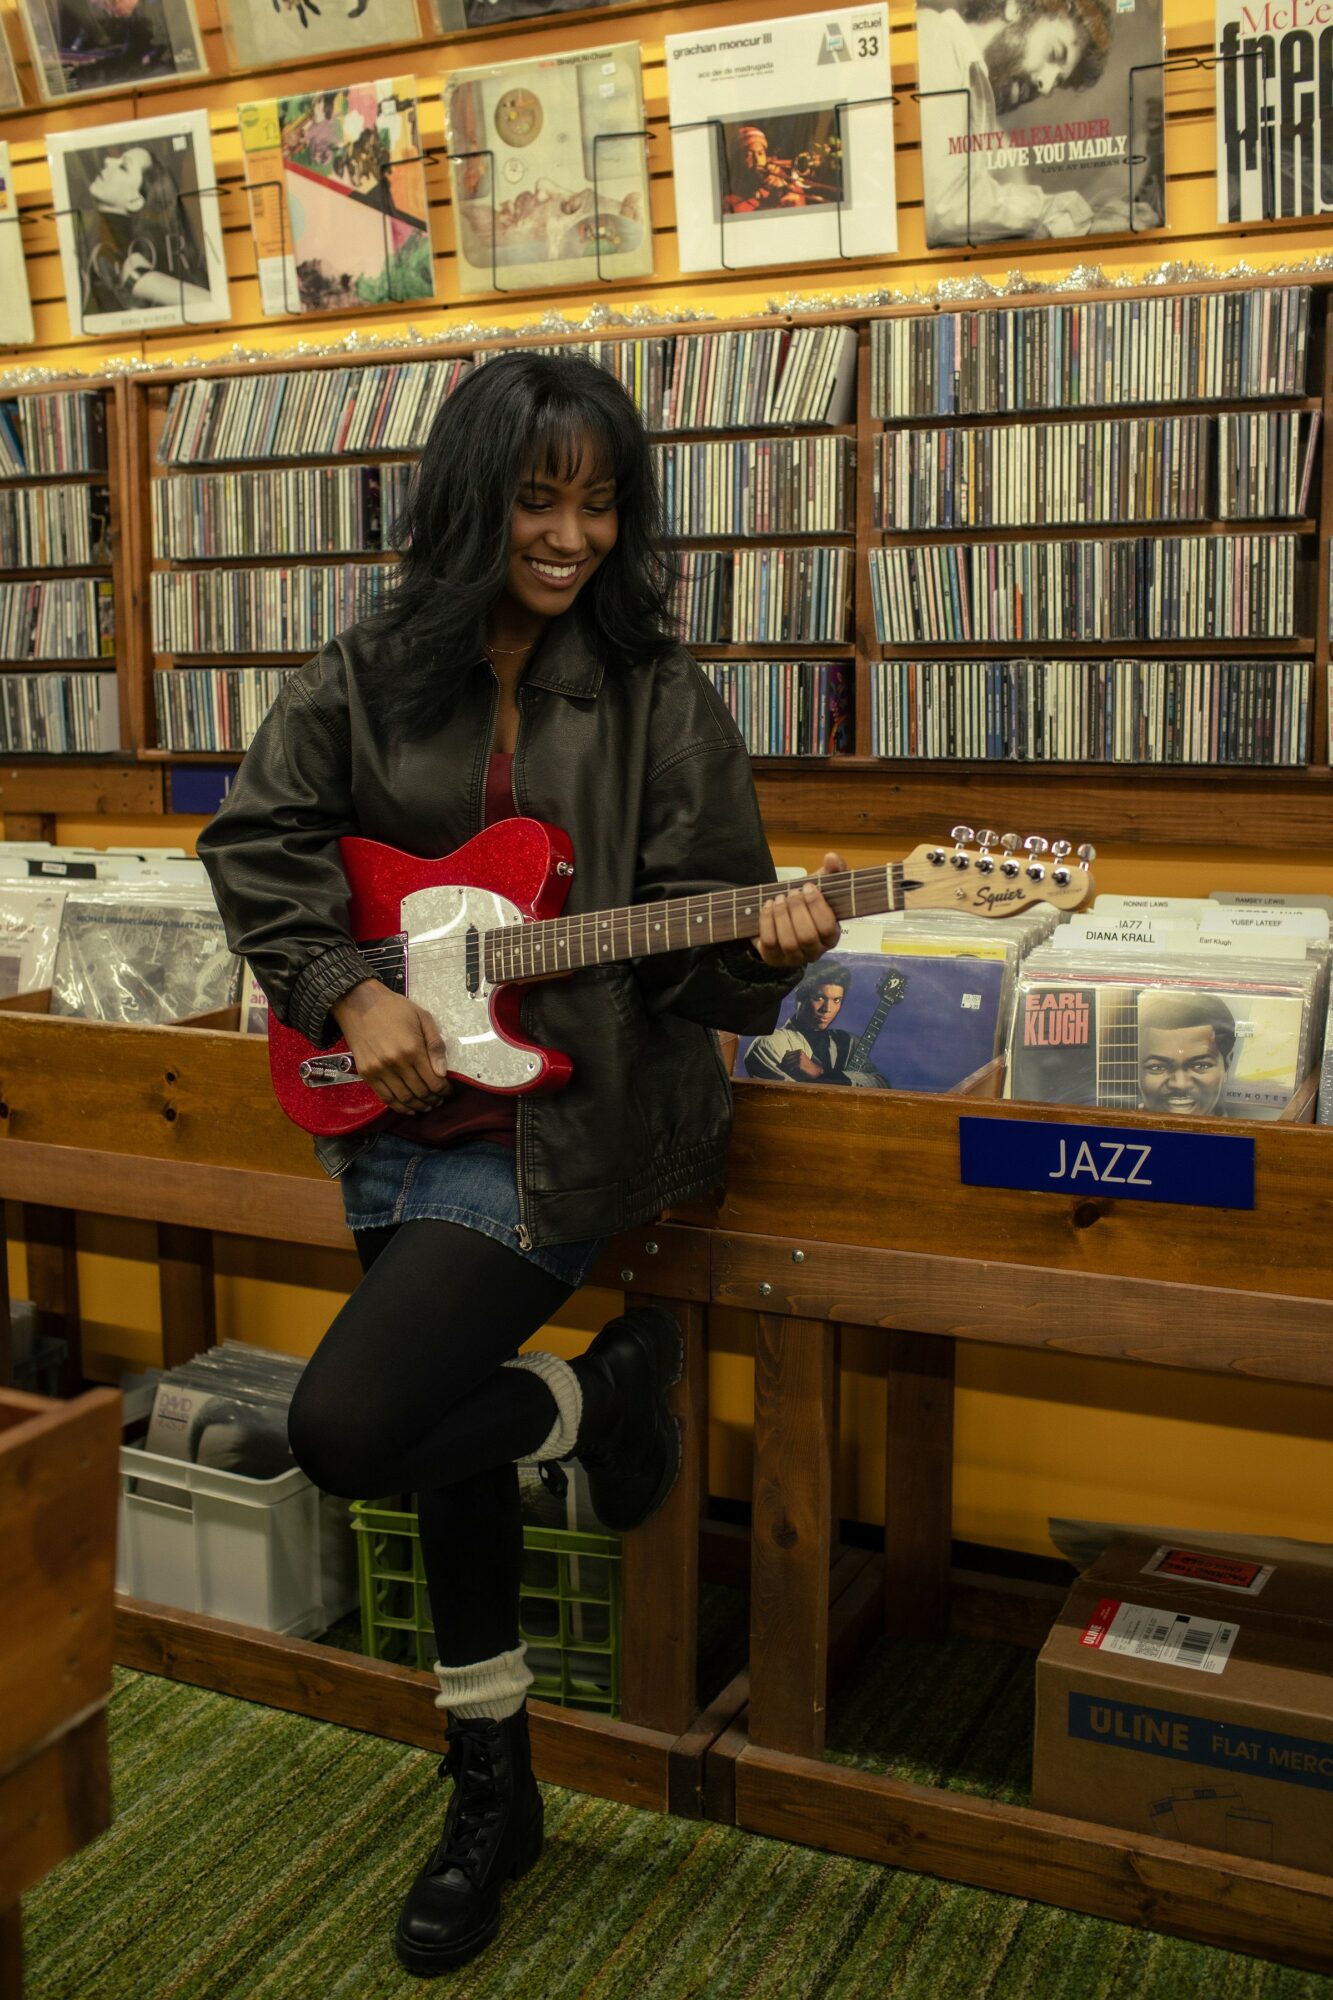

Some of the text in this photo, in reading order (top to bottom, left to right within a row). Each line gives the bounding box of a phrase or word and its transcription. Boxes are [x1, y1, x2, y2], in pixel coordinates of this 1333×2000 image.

[852, 17, 882, 31] actuel
[673, 40, 717, 60] grachan
[719, 36, 761, 51] moncur
[858, 36, 879, 58] 33
[948, 118, 1111, 155] MONTY ALEXANDER
[987, 147, 1030, 170] LOVE
[1033, 142, 1065, 165] YOU
[1069, 135, 1128, 161] MADLY
[1065, 163, 1077, 172] AT
[973, 887, 1027, 911] Squier
[1235, 897, 1262, 905] RAMSEY
[1231, 919, 1282, 928] YUSEF LATEEF
[1086, 931, 1155, 944] DIANA KRALL
[1199, 937, 1232, 948] Earl Klugh
[1025, 992, 1090, 1011] EARL
[1023, 1009, 1090, 1047] KLUGH
[1049, 1139, 1153, 1185] JAZZ
[1089, 1705, 1333, 1777] ULINE FLAT MERC
